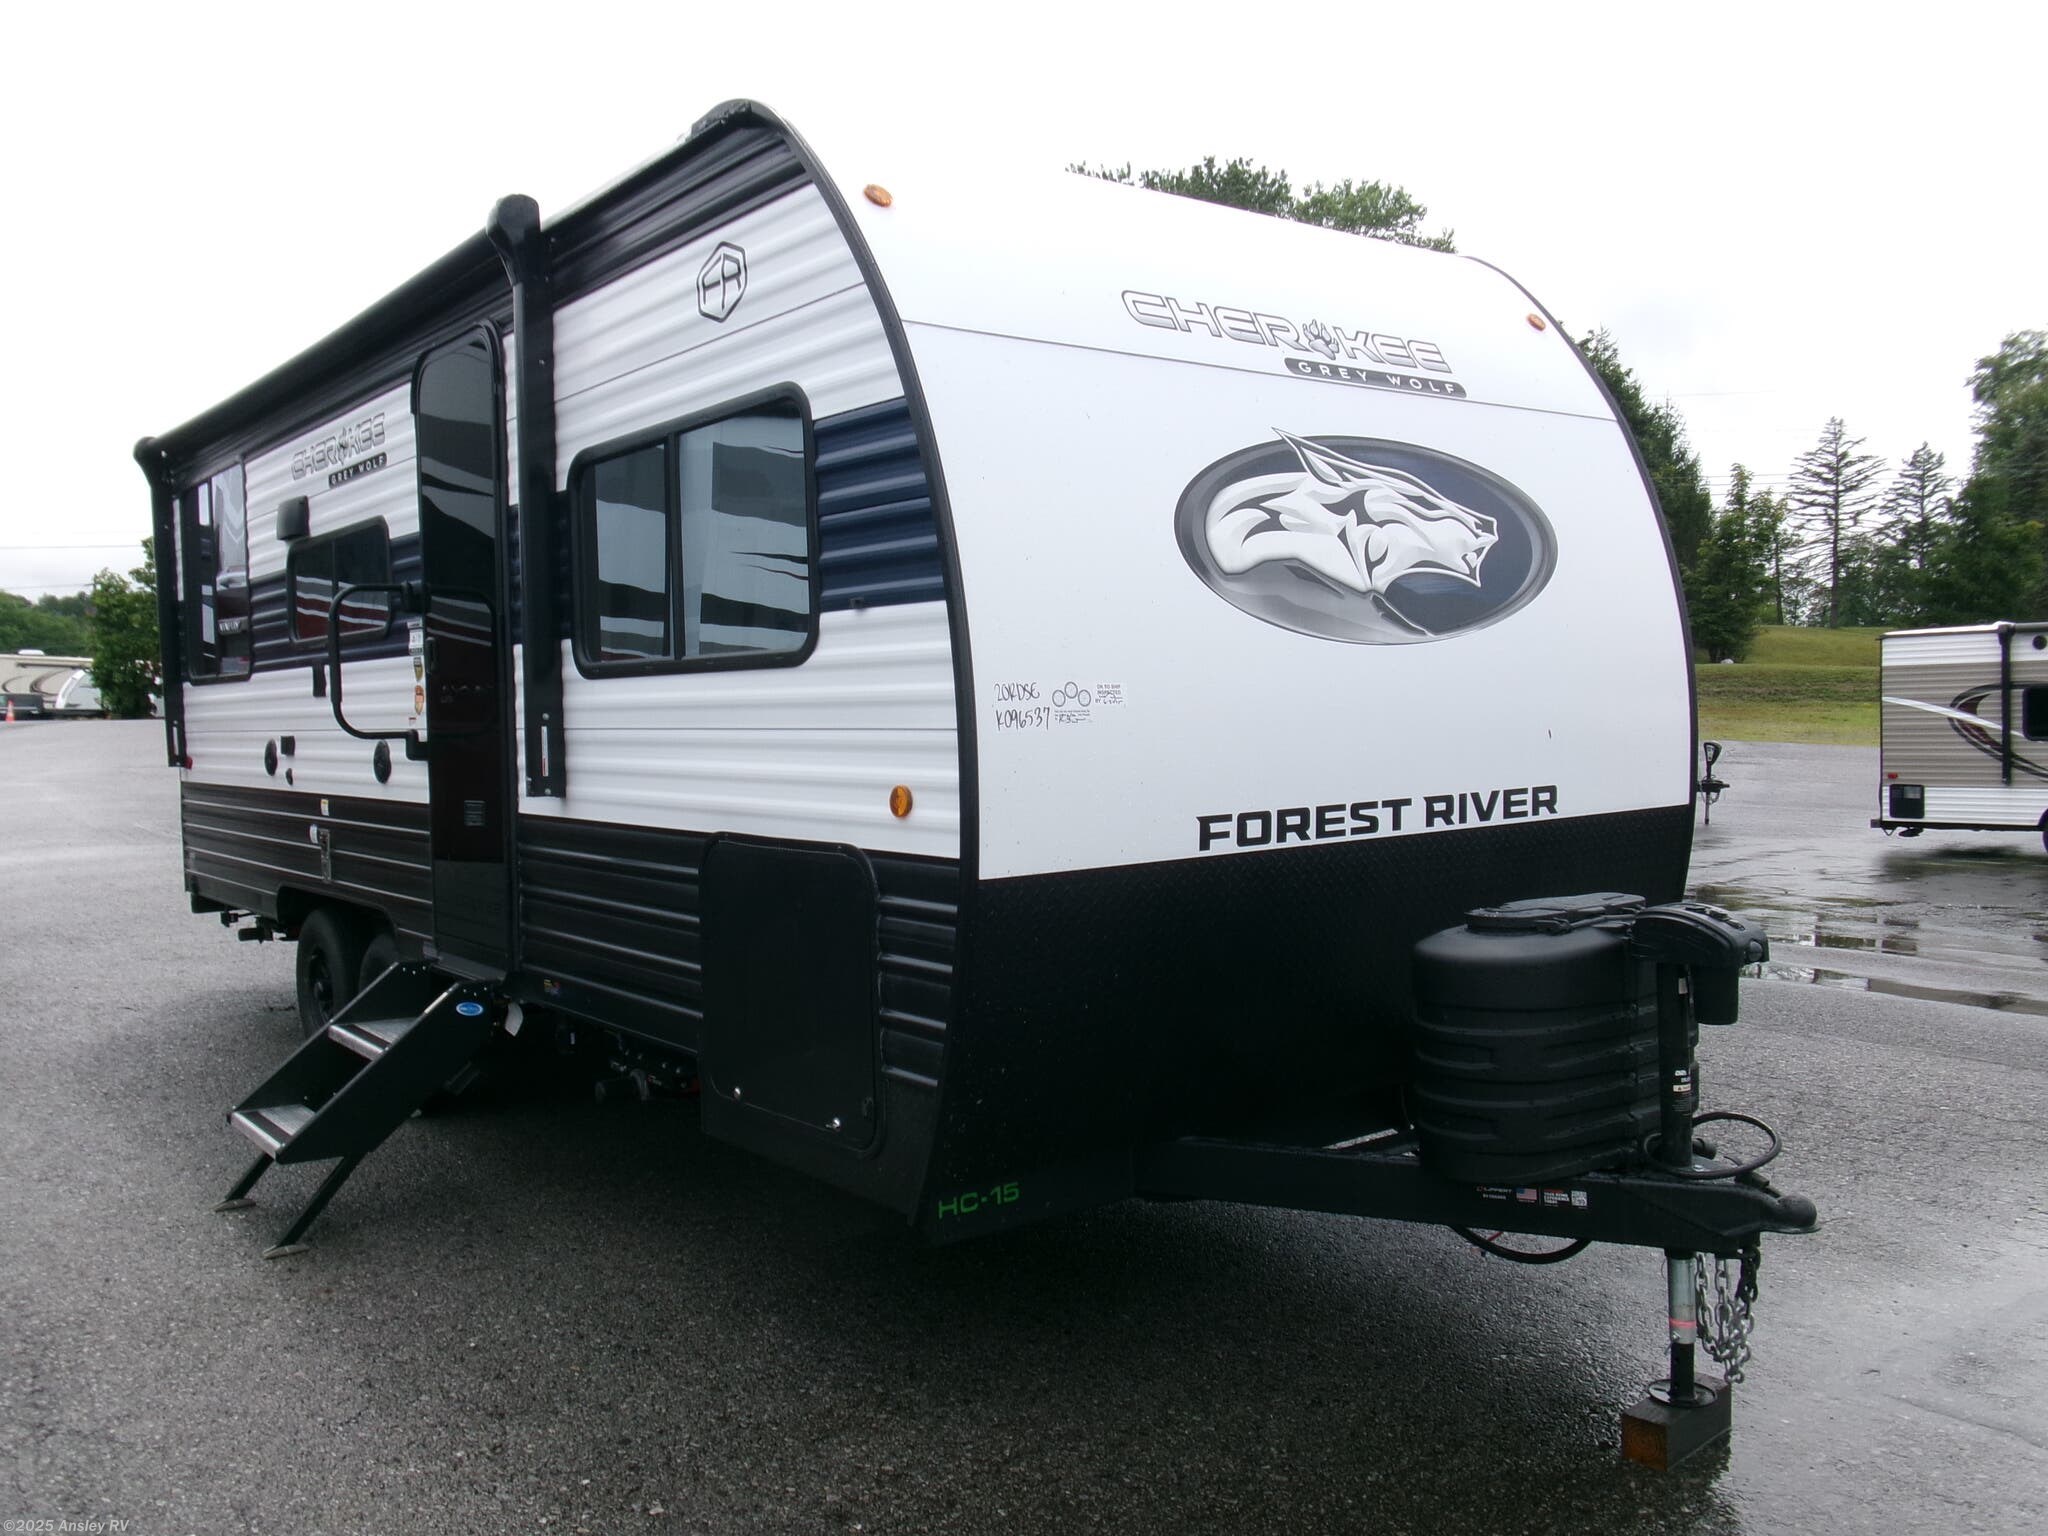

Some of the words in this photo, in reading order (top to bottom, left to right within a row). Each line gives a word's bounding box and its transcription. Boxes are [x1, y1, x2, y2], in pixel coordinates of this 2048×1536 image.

[1298, 361, 1368, 382] GREY
[1386, 374, 1456, 395] WOLF
[331, 468, 355, 485] GREY
[358, 455, 384, 473] WOLF
[995, 706, 1050, 731] K096537
[1196, 798, 1412, 852] FOREST
[1423, 785, 1558, 828] RIVER
